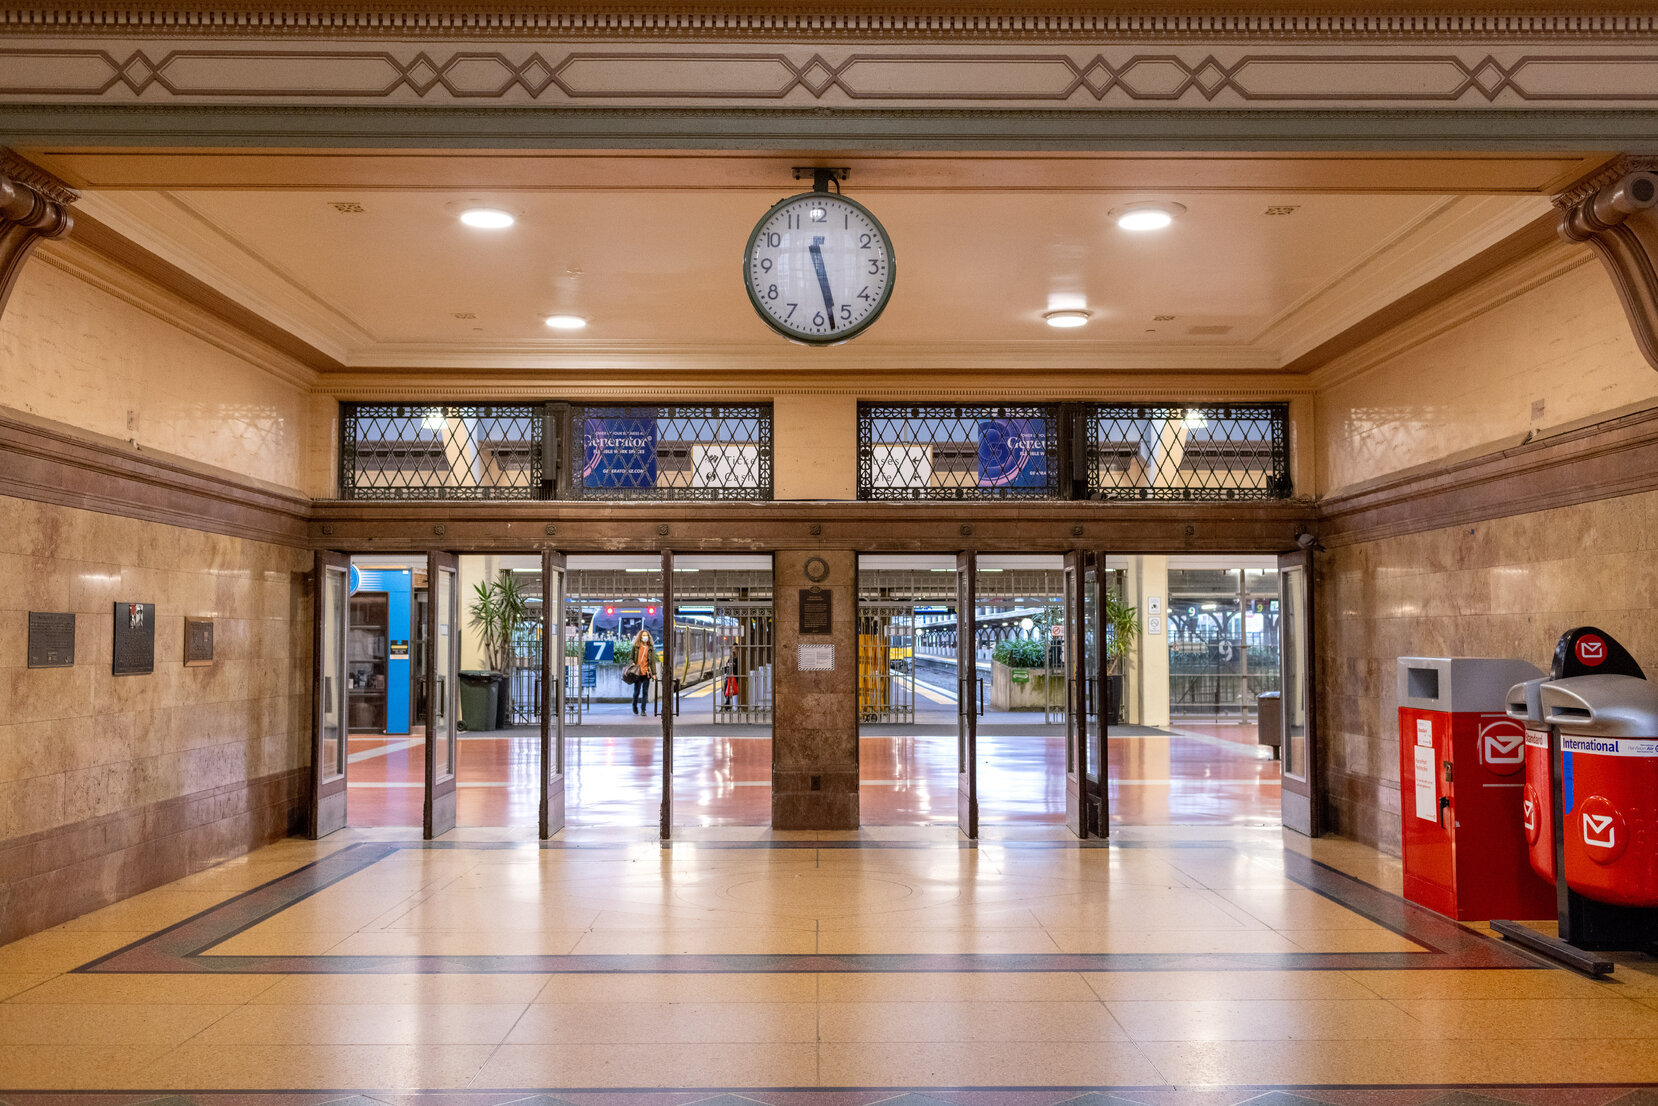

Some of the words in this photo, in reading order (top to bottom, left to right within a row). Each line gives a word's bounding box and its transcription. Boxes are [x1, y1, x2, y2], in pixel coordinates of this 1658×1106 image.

[788, 214, 800, 230] 11
[812, 207, 827, 223] 12
[844, 214, 848, 230] 1
[766, 232, 781, 248] 10
[859, 234, 872, 249] 2
[760, 258, 773, 274] 9
[868, 259, 879, 275] 3
[768, 284, 778, 300] 8
[857, 286, 870, 302] 4
[786, 304, 798, 319] 7
[812, 310, 825, 326] 6
[840, 304, 852, 320] 5
[584, 434, 646, 447] Generator
[726, 456, 756, 465] Ticke
[1188, 606, 1196, 616] 9
[1257, 604, 1264, 612] 9
[593, 642, 606, 660] 7
[1218, 640, 1233, 662] 9
[1562, 738, 1620, 752] International
